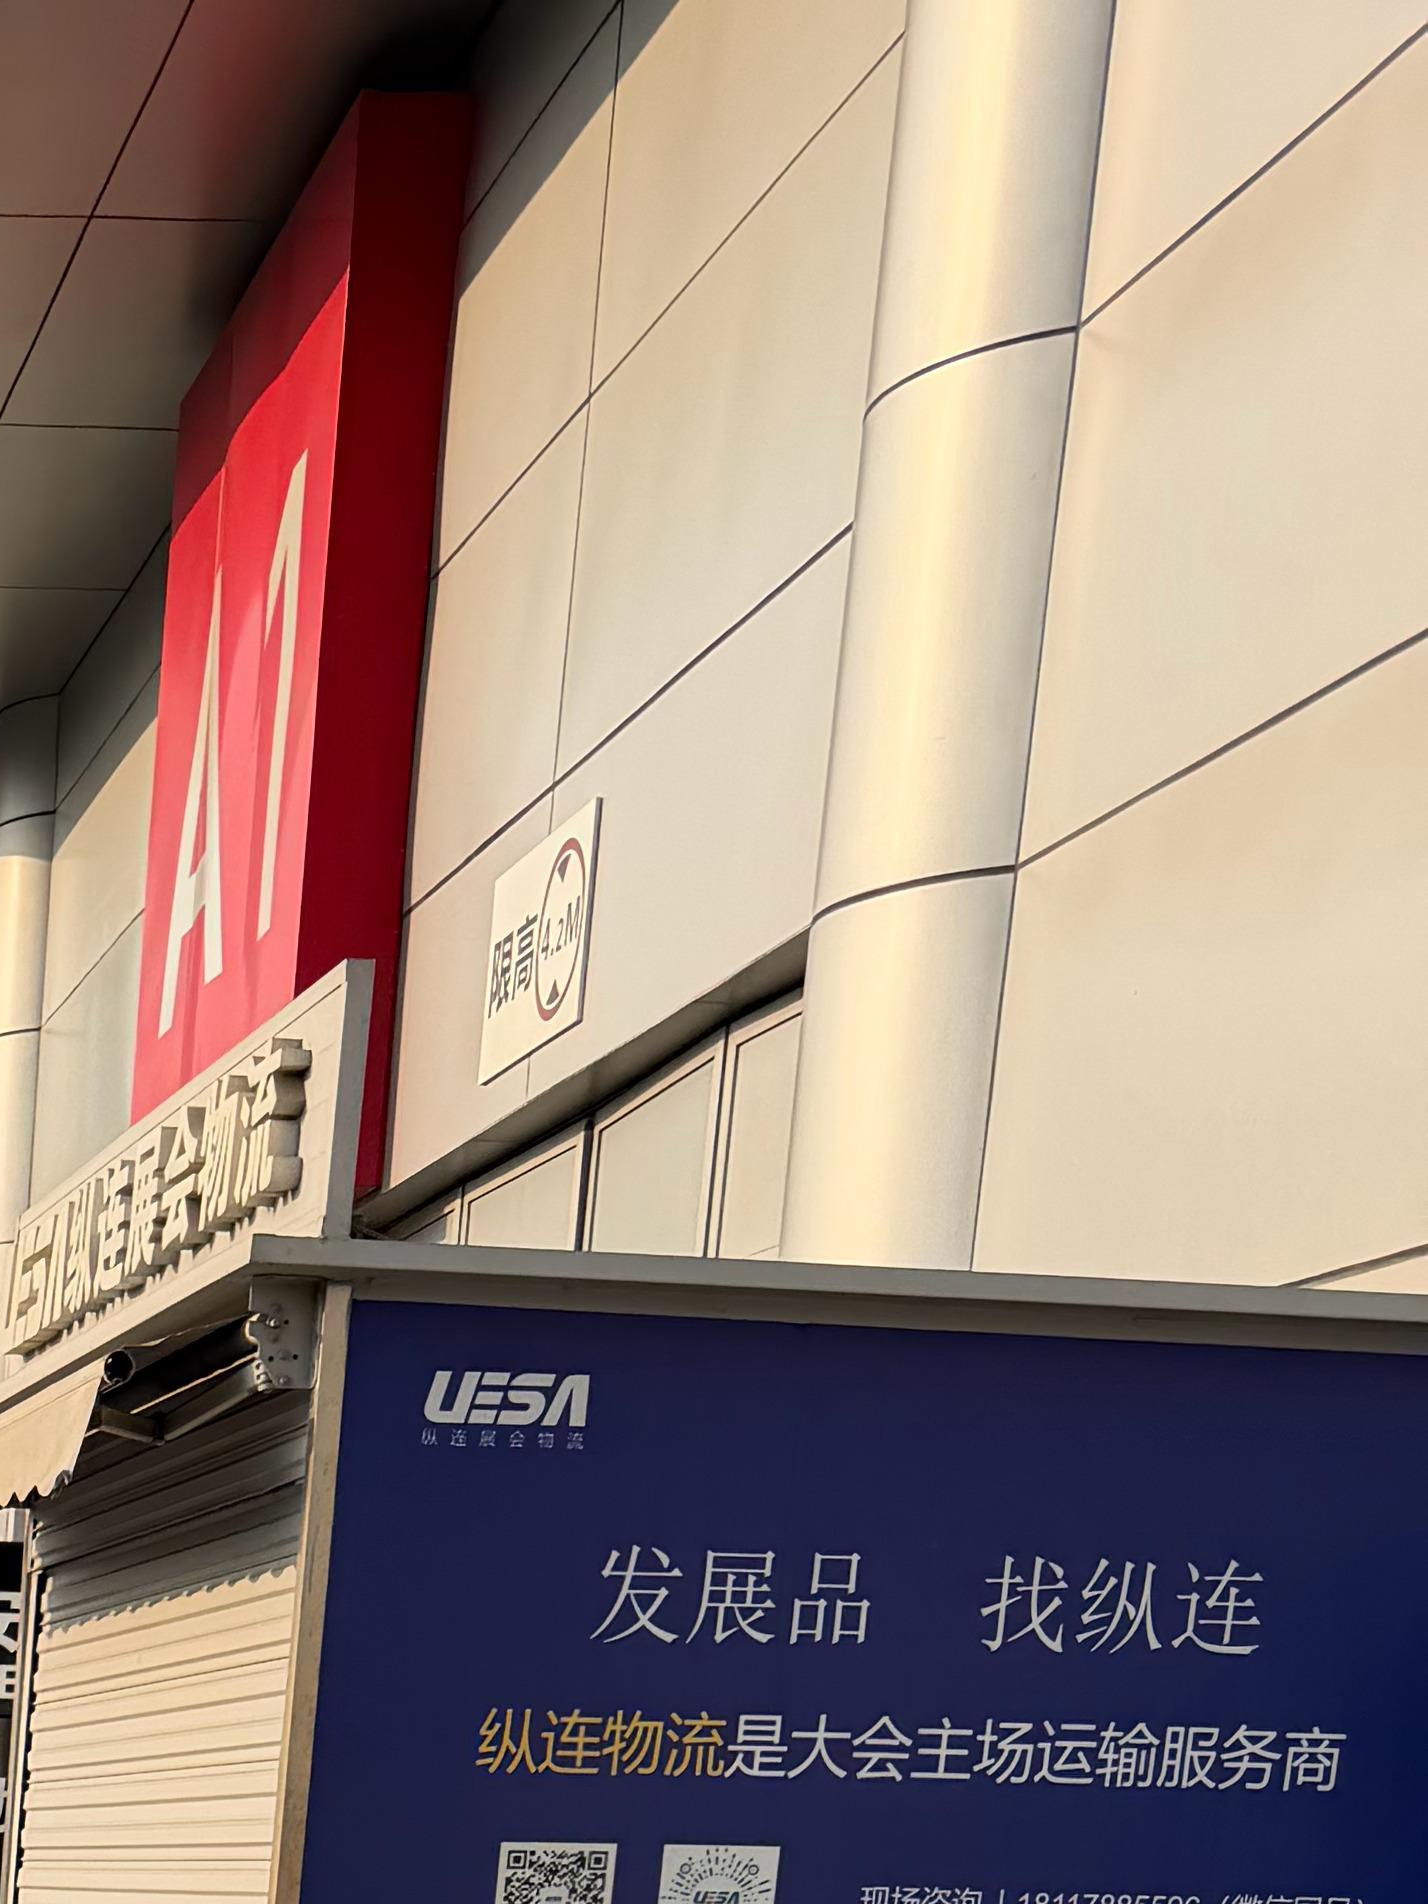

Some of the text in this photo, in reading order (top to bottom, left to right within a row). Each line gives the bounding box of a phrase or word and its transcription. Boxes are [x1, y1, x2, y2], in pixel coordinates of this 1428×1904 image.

[157, 448, 309, 1039] A1
[488, 894, 582, 1020] 限高 4.2M
[423, 1370, 591, 1427] UESA
[590, 1544, 1264, 1655] 发展品 找纵连
[476, 1707, 1347, 1792] 纵连物流是大会主场运输服务商
